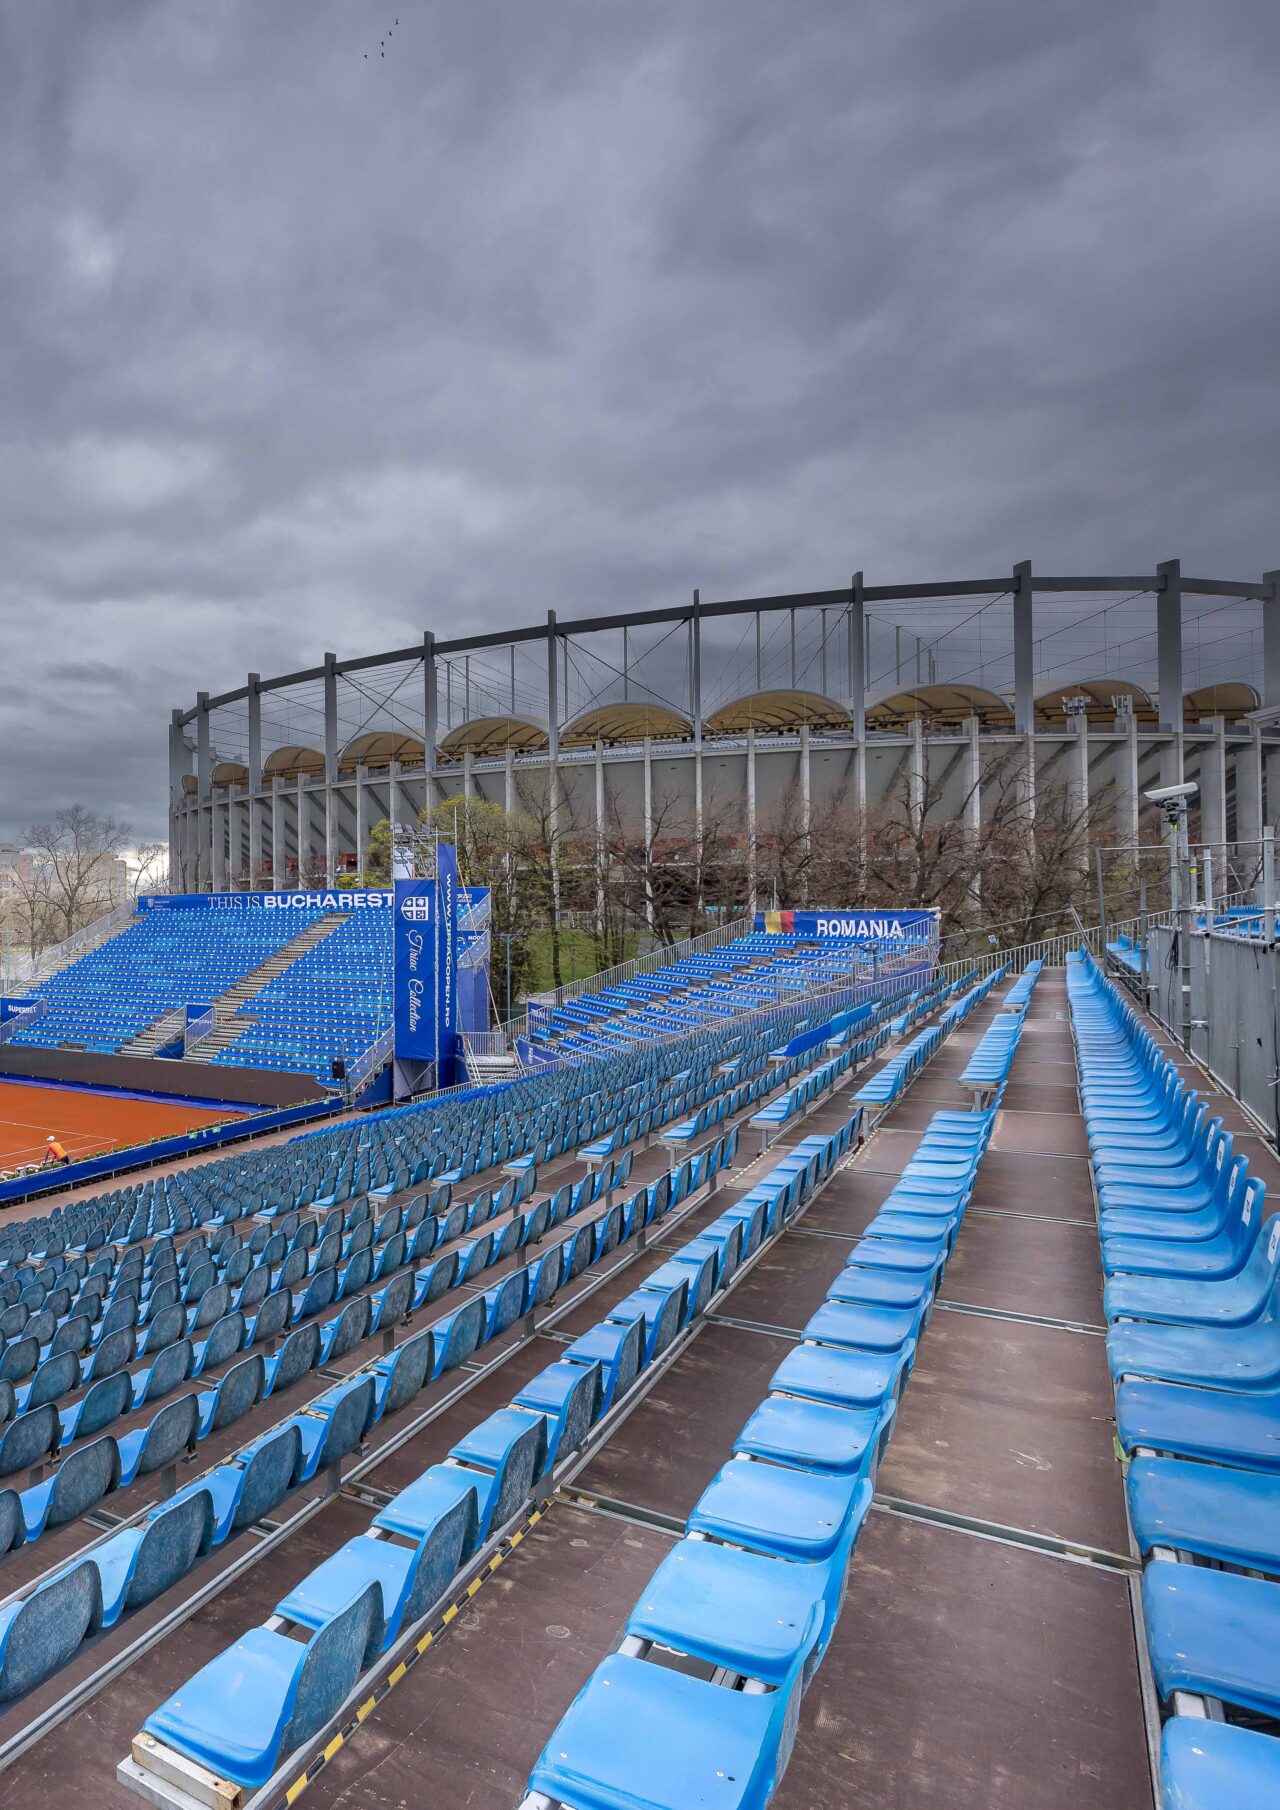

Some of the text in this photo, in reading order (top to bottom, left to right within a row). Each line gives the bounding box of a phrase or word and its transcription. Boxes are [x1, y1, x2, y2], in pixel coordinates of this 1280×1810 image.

[208, 893, 395, 910] THIS IS BUCHAREST
[817, 920, 904, 937] ROMANIA
[8, 1004, 37, 1014] SUPERBET
[407, 978, 424, 1033] Collection
